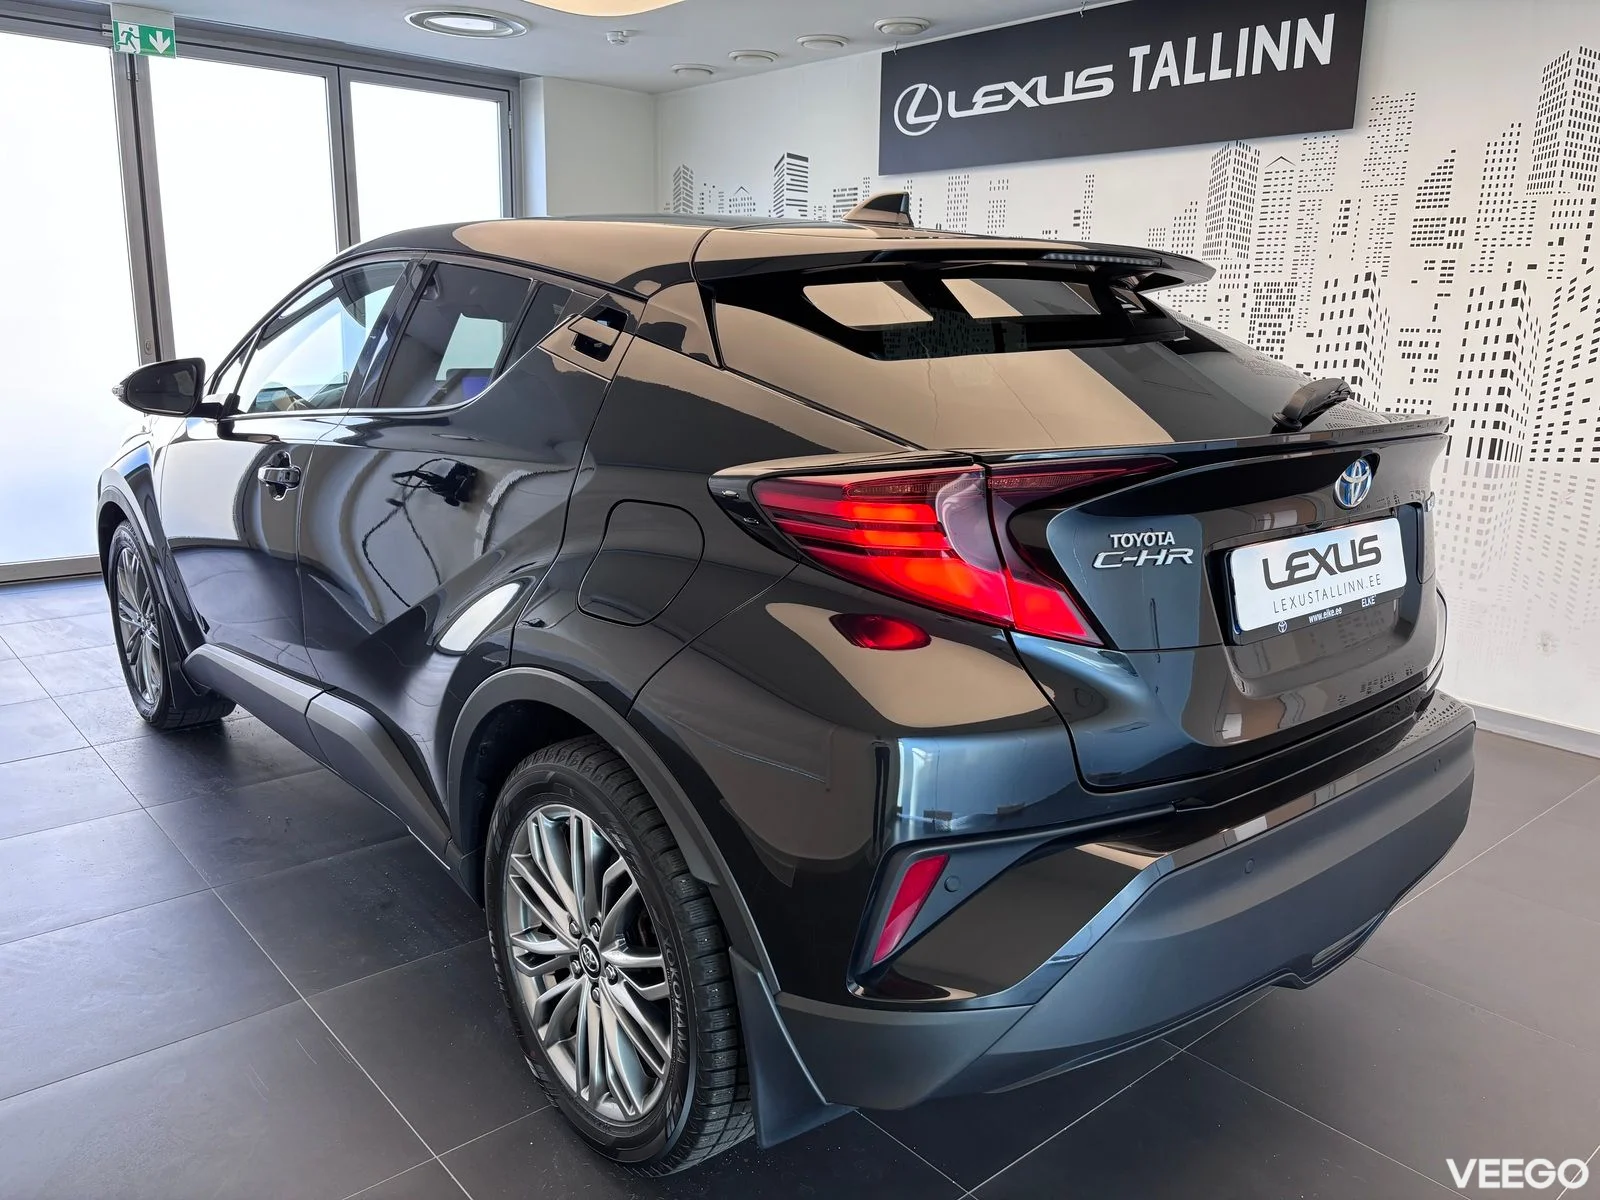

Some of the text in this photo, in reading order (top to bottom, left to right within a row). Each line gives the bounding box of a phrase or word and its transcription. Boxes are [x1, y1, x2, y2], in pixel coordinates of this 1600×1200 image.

[947, 13, 1335, 119] LEXUS TALLINN
[1093, 547, 1194, 569] C-HR
[1110, 531, 1176, 548] TOYOTA
[1262, 534, 1382, 591] LEXUS
[1273, 573, 1381, 614] LEXUSTALLINN.EE
[663, 936, 688, 1064] YOKOHAMA
